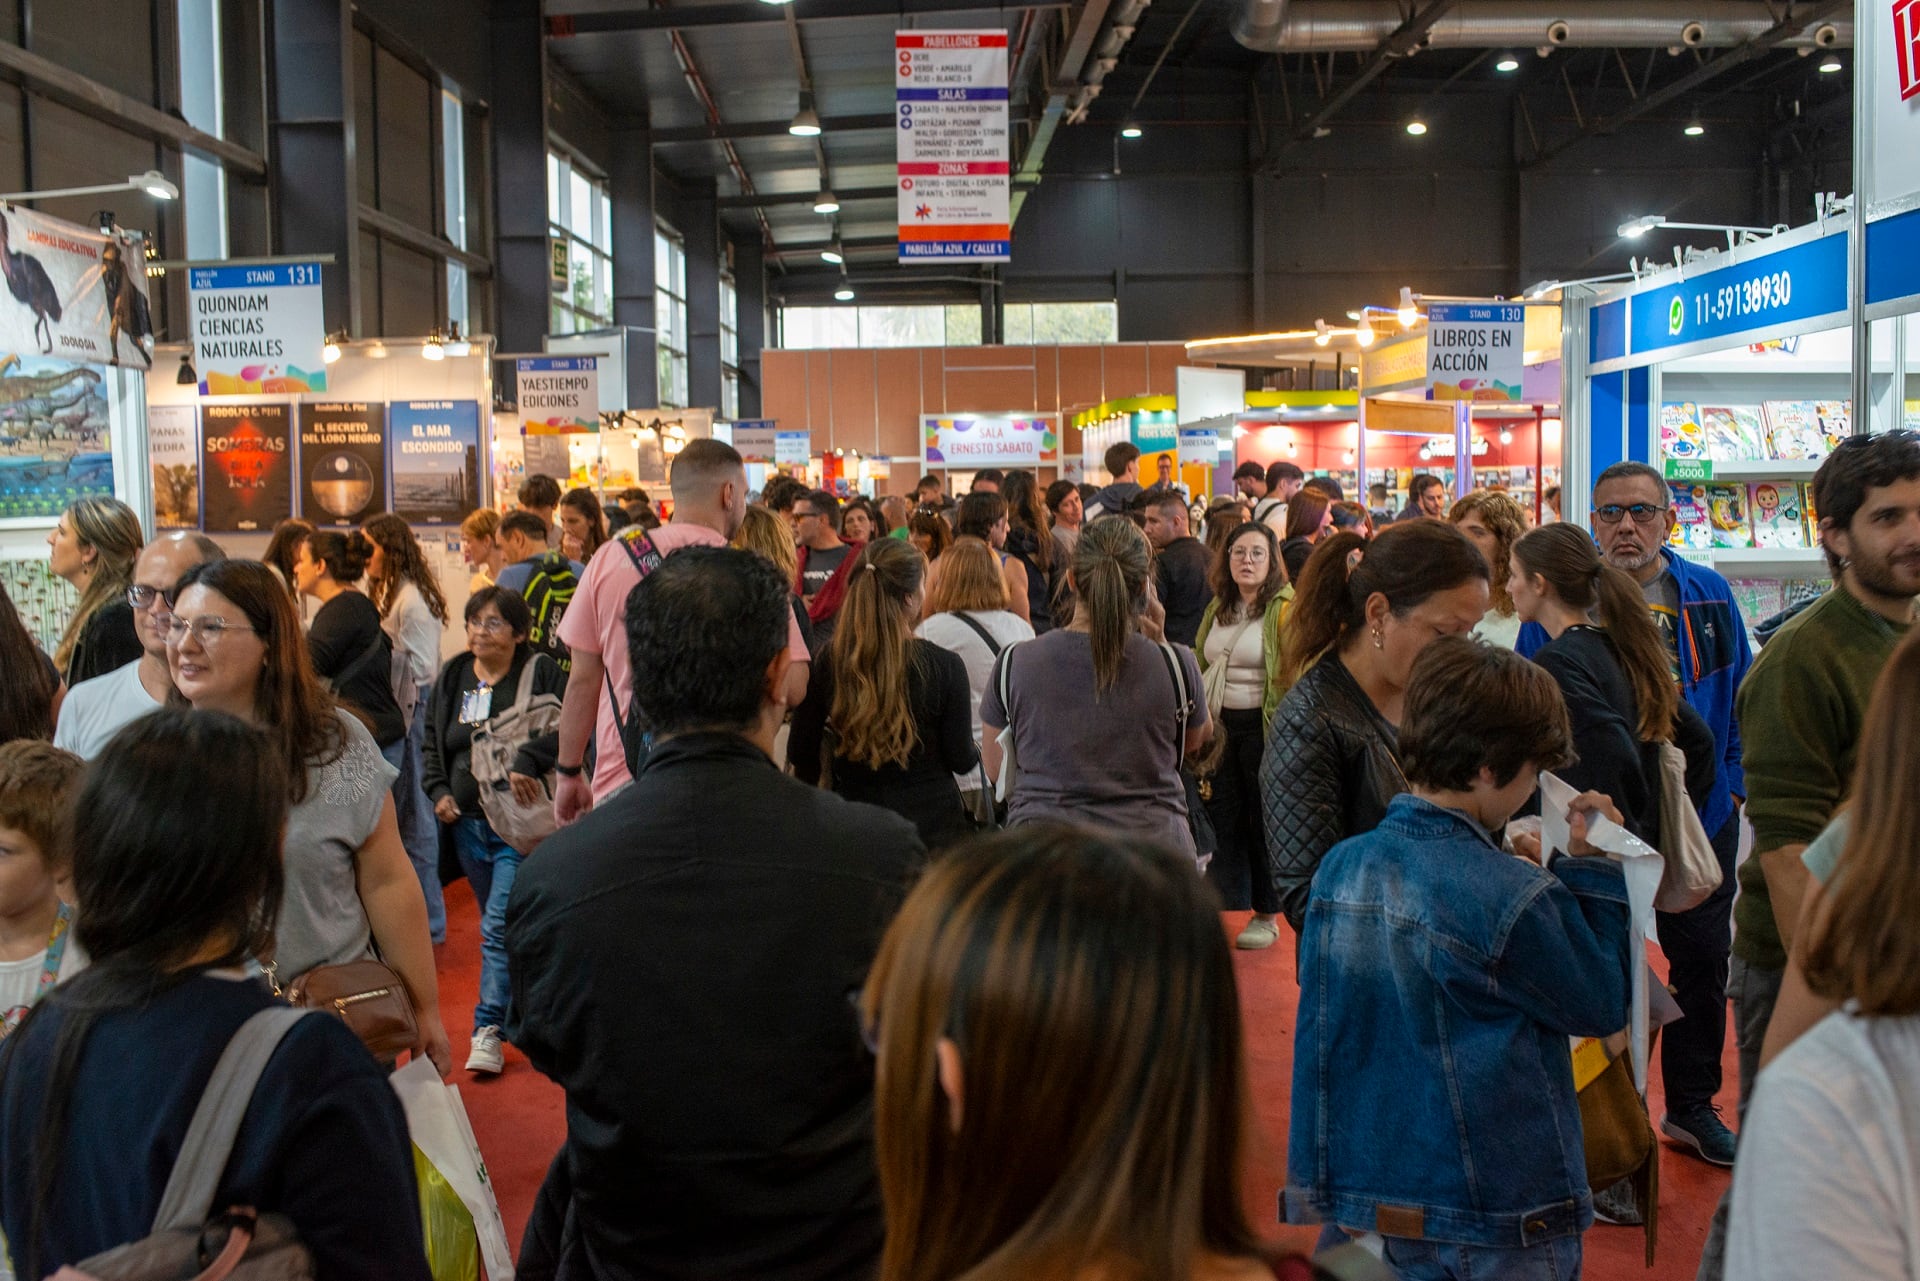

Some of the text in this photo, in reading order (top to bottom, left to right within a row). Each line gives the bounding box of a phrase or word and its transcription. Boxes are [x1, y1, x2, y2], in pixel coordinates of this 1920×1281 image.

[923, 35, 980, 48] PABELLONES
[914, 64, 972, 72] VERDE AMARILLO
[936, 74, 961, 82] BLANCO
[938, 89, 967, 100] SALAS
[914, 105, 939, 113] SABATO
[914, 119, 946, 127] CORTÁZAR
[914, 129, 937, 137] WALSH
[914, 138, 952, 147] HERNÁNDEZ
[915, 149, 950, 157] SARMIENTO
[972, 148, 999, 156] CASARES
[938, 163, 968, 175] ZONAS
[915, 178, 1004, 187] FUTURO DIGITAL EXPLORA
[916, 189, 987, 197] INFANTIL STREAMING
[27, 229, 98, 260] LAMINAS EDUCATIVAS
[905, 242, 944, 255] PABELLÓN
[945, 243, 964, 254] AZUL
[972, 243, 996, 254] CALLE
[998, 243, 1002, 254] 1
[246, 270, 275, 284] STAND
[287, 265, 314, 285] 131
[195, 279, 213, 288] AZUL
[1695, 270, 1791, 326] 11-59138930
[198, 294, 269, 315] QUONDAM
[1469, 309, 1491, 319] STAND
[1500, 307, 1521, 321] 130
[199, 317, 264, 336] CIENCIAS
[60, 335, 97, 351] ZOOLOGIA
[1433, 329, 1511, 347] LIBROS EN
[201, 339, 283, 359] NATURALES
[551, 360, 570, 368] STAND
[1432, 348, 1488, 371] ACCIÓN
[521, 376, 589, 391] YAESTIEMPO
[522, 394, 579, 408] EDICIONES
[209, 407, 250, 417] RODOLFO
[313, 422, 369, 432] EL SECRETO
[412, 424, 451, 438] EL MAR
[979, 427, 1004, 438] SALA
[206, 436, 286, 453] SOMBRAS
[302, 433, 382, 444] DEL LOBO NEGRO
[402, 441, 463, 453] ESCONDIDO
[950, 442, 1033, 455] ERNESTO SABATO
[1674, 468, 1705, 478] $5000
